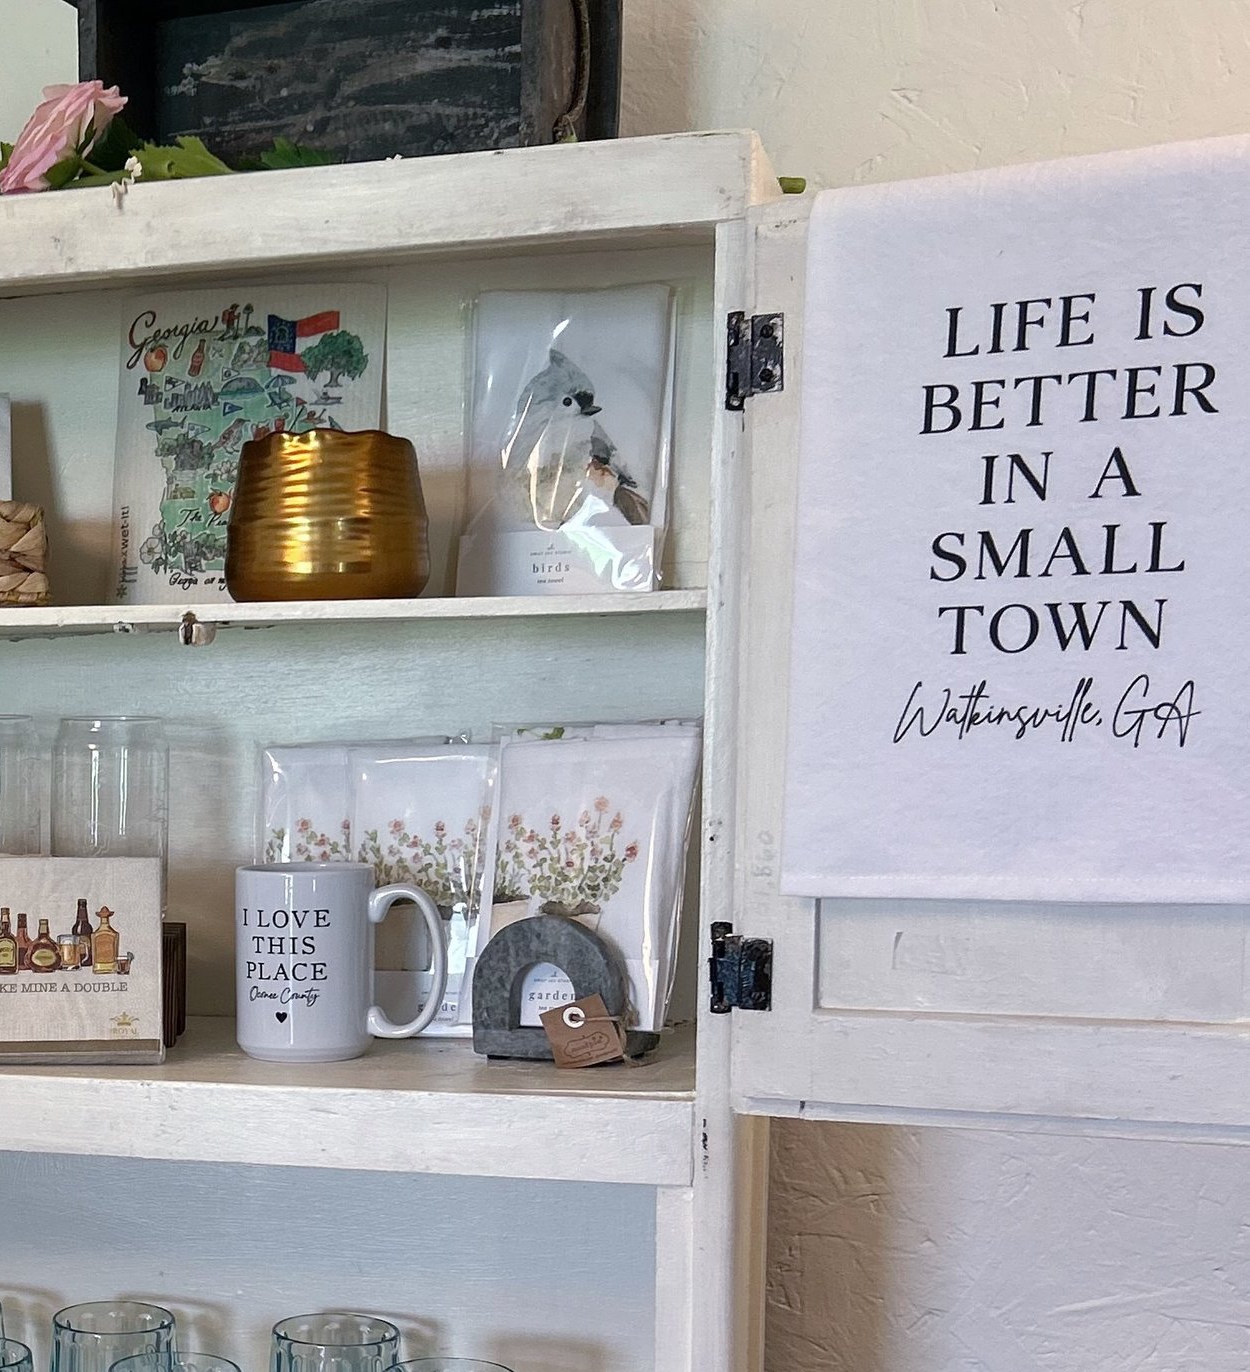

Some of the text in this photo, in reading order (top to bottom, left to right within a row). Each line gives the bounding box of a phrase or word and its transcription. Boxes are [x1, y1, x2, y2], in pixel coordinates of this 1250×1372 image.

[126, 310, 219, 369] Georgia
[942, 283, 1205, 358] LIFE IS
[918, 361, 1219, 435] BETTER
[978, 446, 1142, 505] IN A
[532, 561, 570, 573] birds
[929, 521, 1185, 582] SMALL
[938, 598, 1168, 655] TOWN
[893, 674, 1202, 748] Watkinsville, GA
[242, 908, 331, 929] I LOVE
[252, 936, 316, 955] THIS
[21, 982, 57, 993] MINE
[60, 982, 71, 993] A
[73, 981, 128, 993] DOUBLE
[246, 961, 328, 981] PLACE
[279, 987, 320, 1007] County
